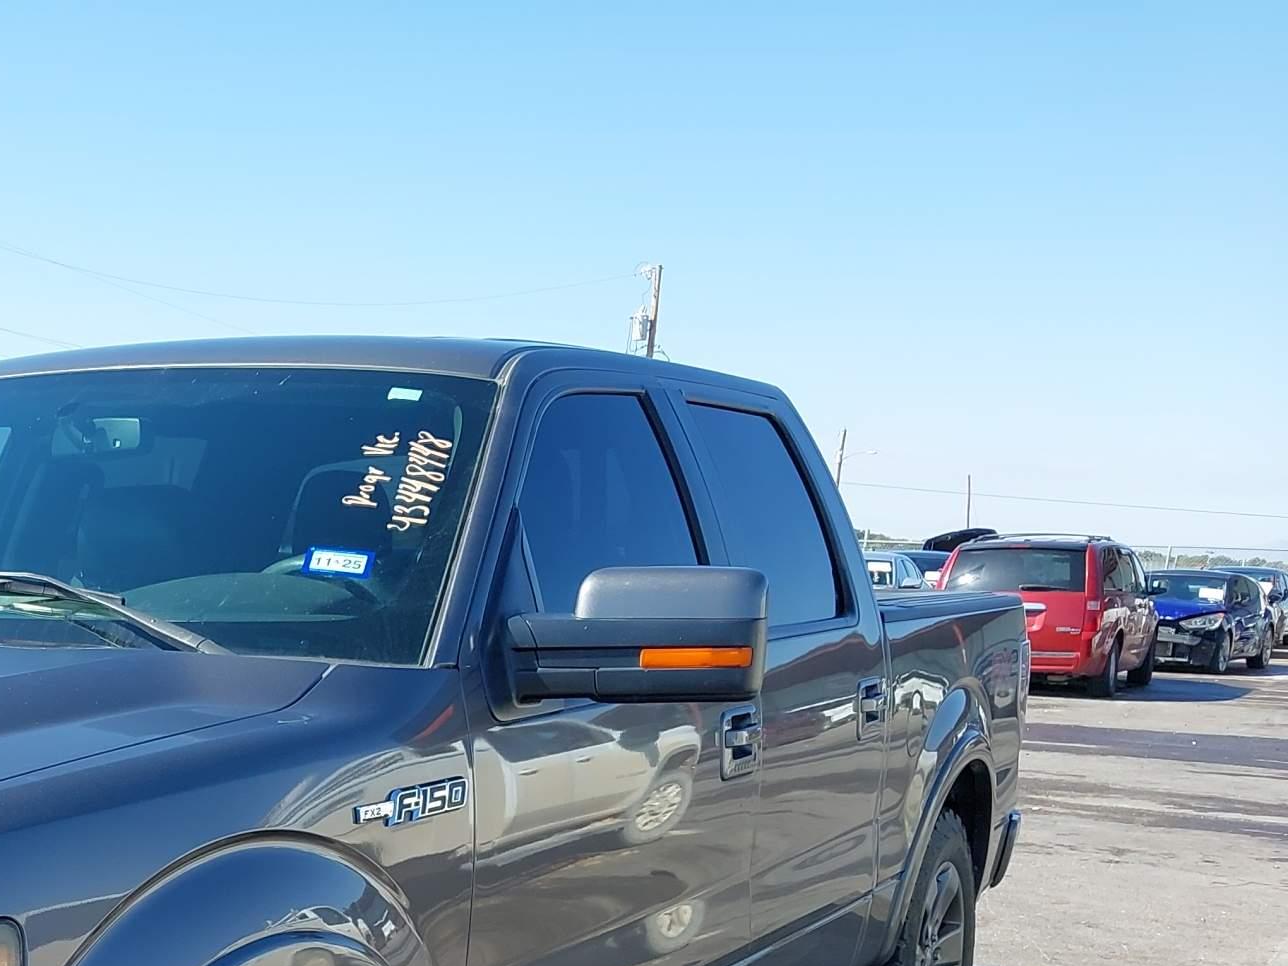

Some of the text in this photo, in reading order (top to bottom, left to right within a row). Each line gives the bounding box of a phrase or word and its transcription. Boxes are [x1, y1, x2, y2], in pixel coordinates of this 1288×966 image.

[386, 430, 453, 532] 43448448
[364, 778, 469, 823] FX2 F-150
